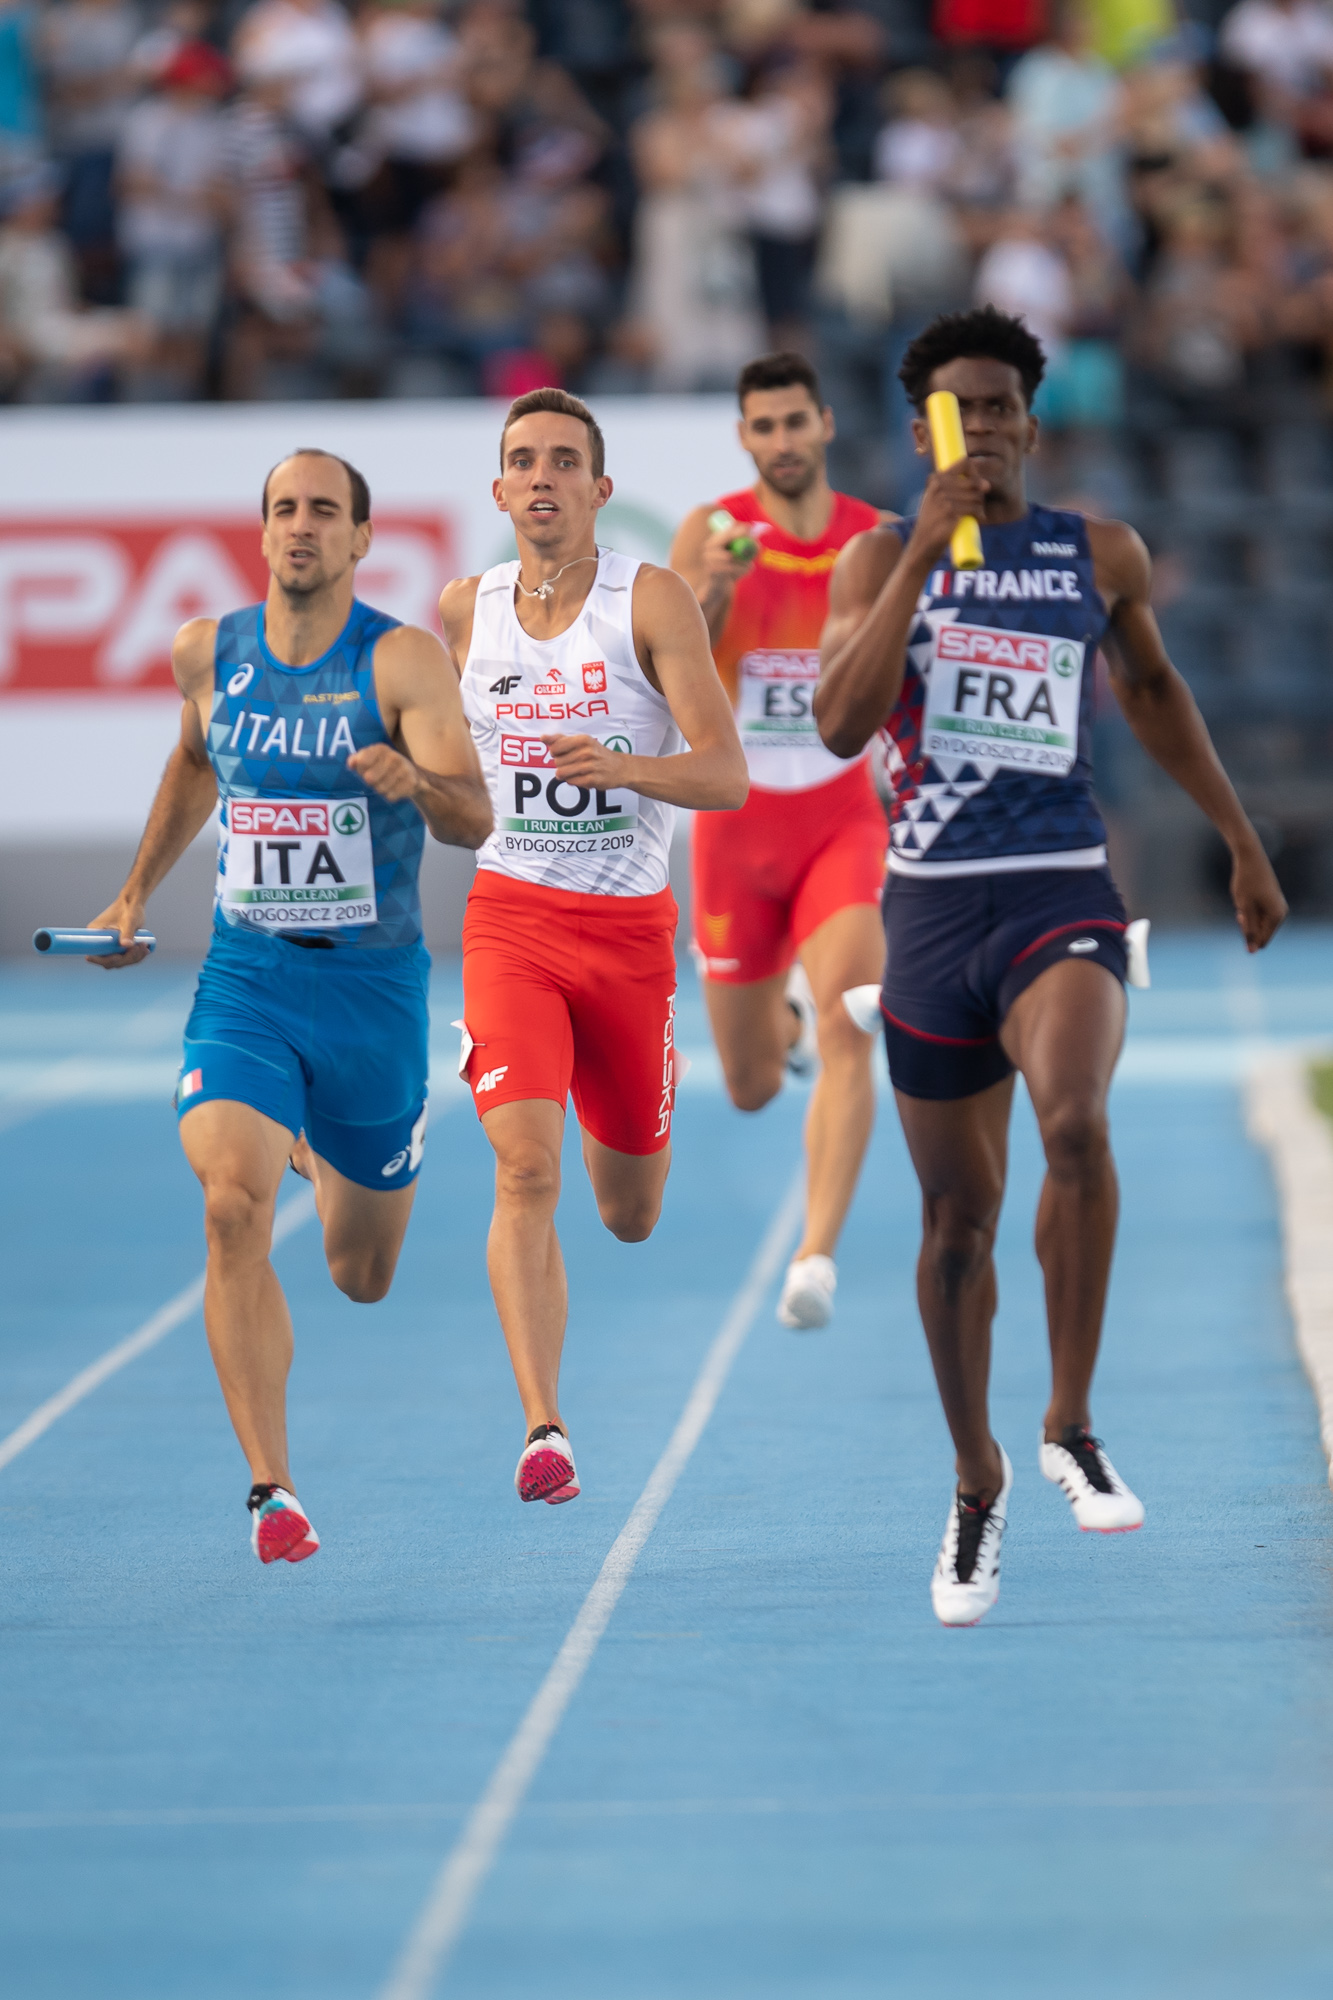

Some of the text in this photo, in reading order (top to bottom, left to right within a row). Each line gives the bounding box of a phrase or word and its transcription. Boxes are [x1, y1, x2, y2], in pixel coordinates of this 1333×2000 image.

[1031, 541, 1078, 558] MAIF
[953, 568, 1083, 600] FRANCE
[940, 629, 1048, 670] SPAR
[489, 675, 523, 695] 4F
[535, 684, 564, 694] ORLEN
[954, 667, 1058, 726] FRA
[496, 699, 610, 720] POLSKA
[764, 684, 812, 717] ES
[229, 709, 358, 757] ITALIA
[966, 719, 996, 735] RUN
[929, 734, 1035, 760] BYDGOSZCZ
[514, 771, 622, 817] POL
[232, 806, 328, 832] SPAR
[530, 820, 559, 832] RUN
[505, 834, 634, 853] BYDGOSZCZ 2019
[253, 840, 346, 885] ITA
[260, 889, 290, 902] RUN
[335, 903, 372, 920] 2019
[655, 993, 676, 1138] POLSKA
[476, 1065, 509, 1094] 4F
